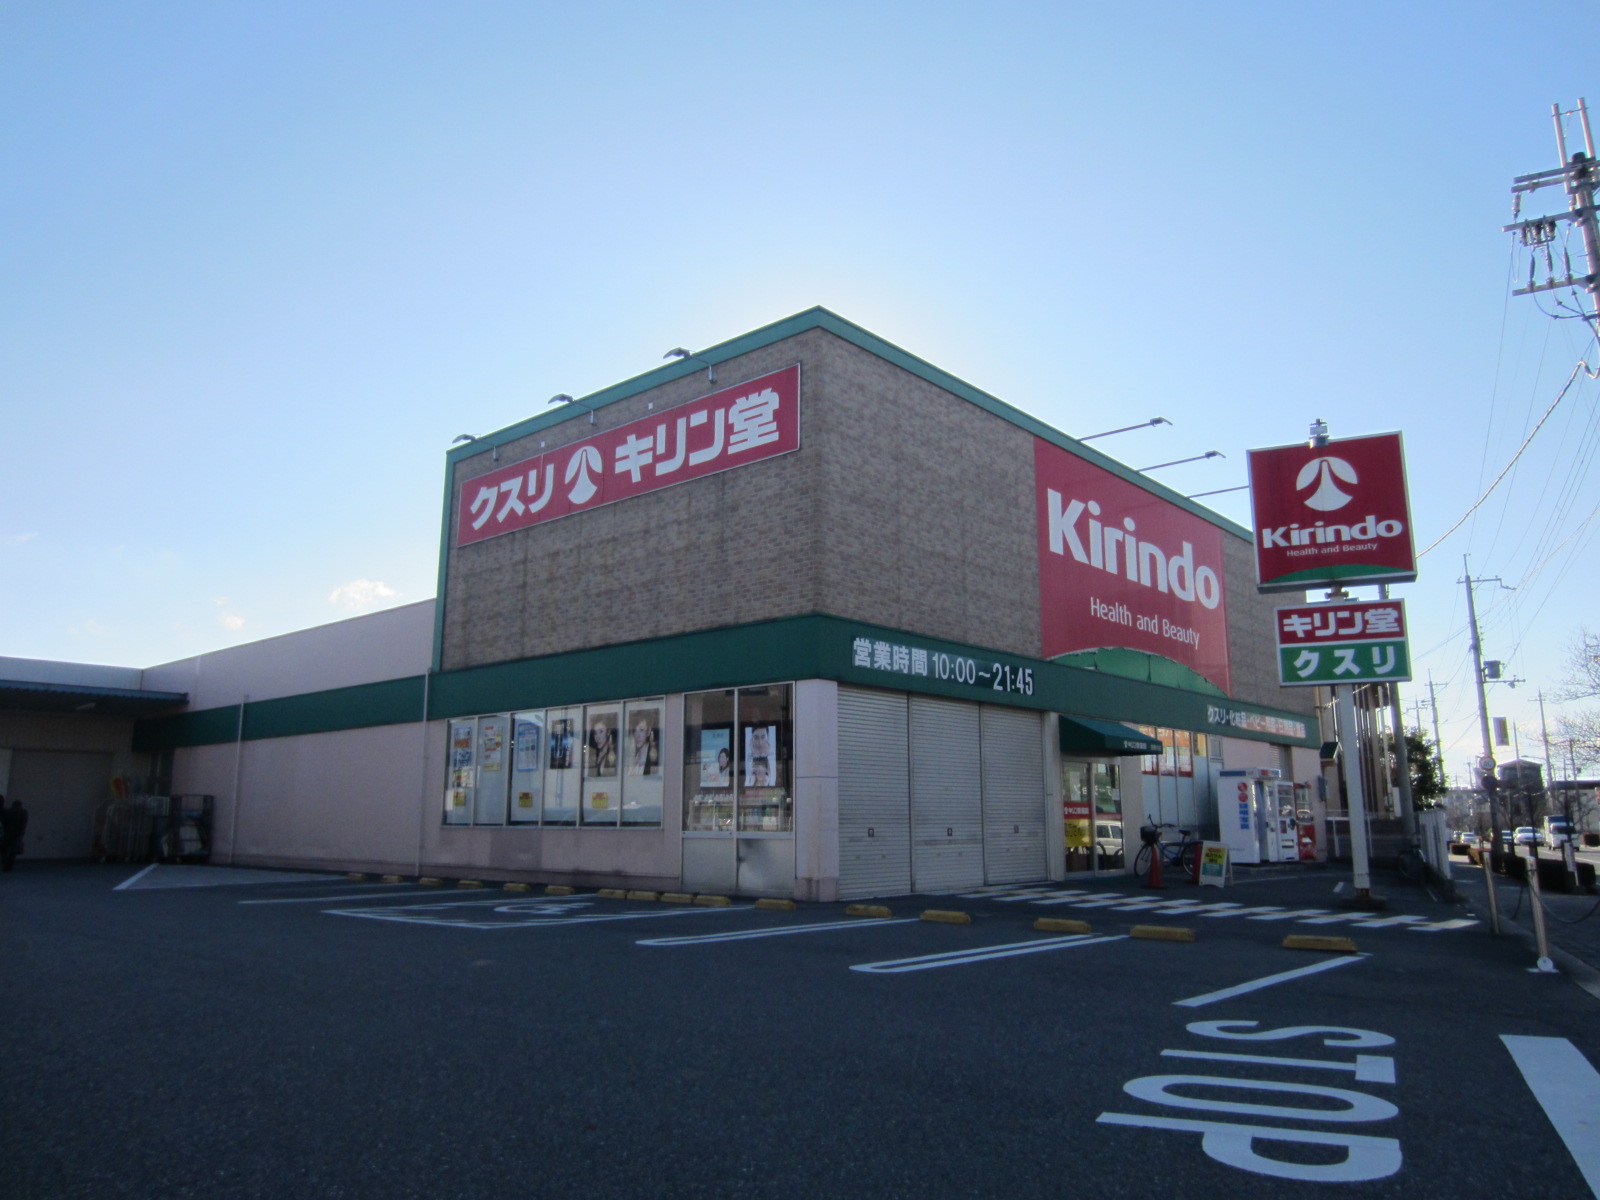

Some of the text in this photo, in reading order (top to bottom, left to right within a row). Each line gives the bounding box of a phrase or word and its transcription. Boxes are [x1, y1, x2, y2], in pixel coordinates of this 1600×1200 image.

[470, 387, 779, 530] クスリ キリン堂
[1047, 488, 1219, 610] Kirindo
[1263, 515, 1402, 548] Kirindo
[1286, 542, 1378, 557] Health and Beauty
[1090, 597, 1200, 650] Health and Beauty
[1283, 607, 1400, 638] キリン堂
[853, 637, 928, 677] 営業時間
[1294, 646, 1395, 677] クスリ
[1095, 1020, 1403, 1182] STOP
